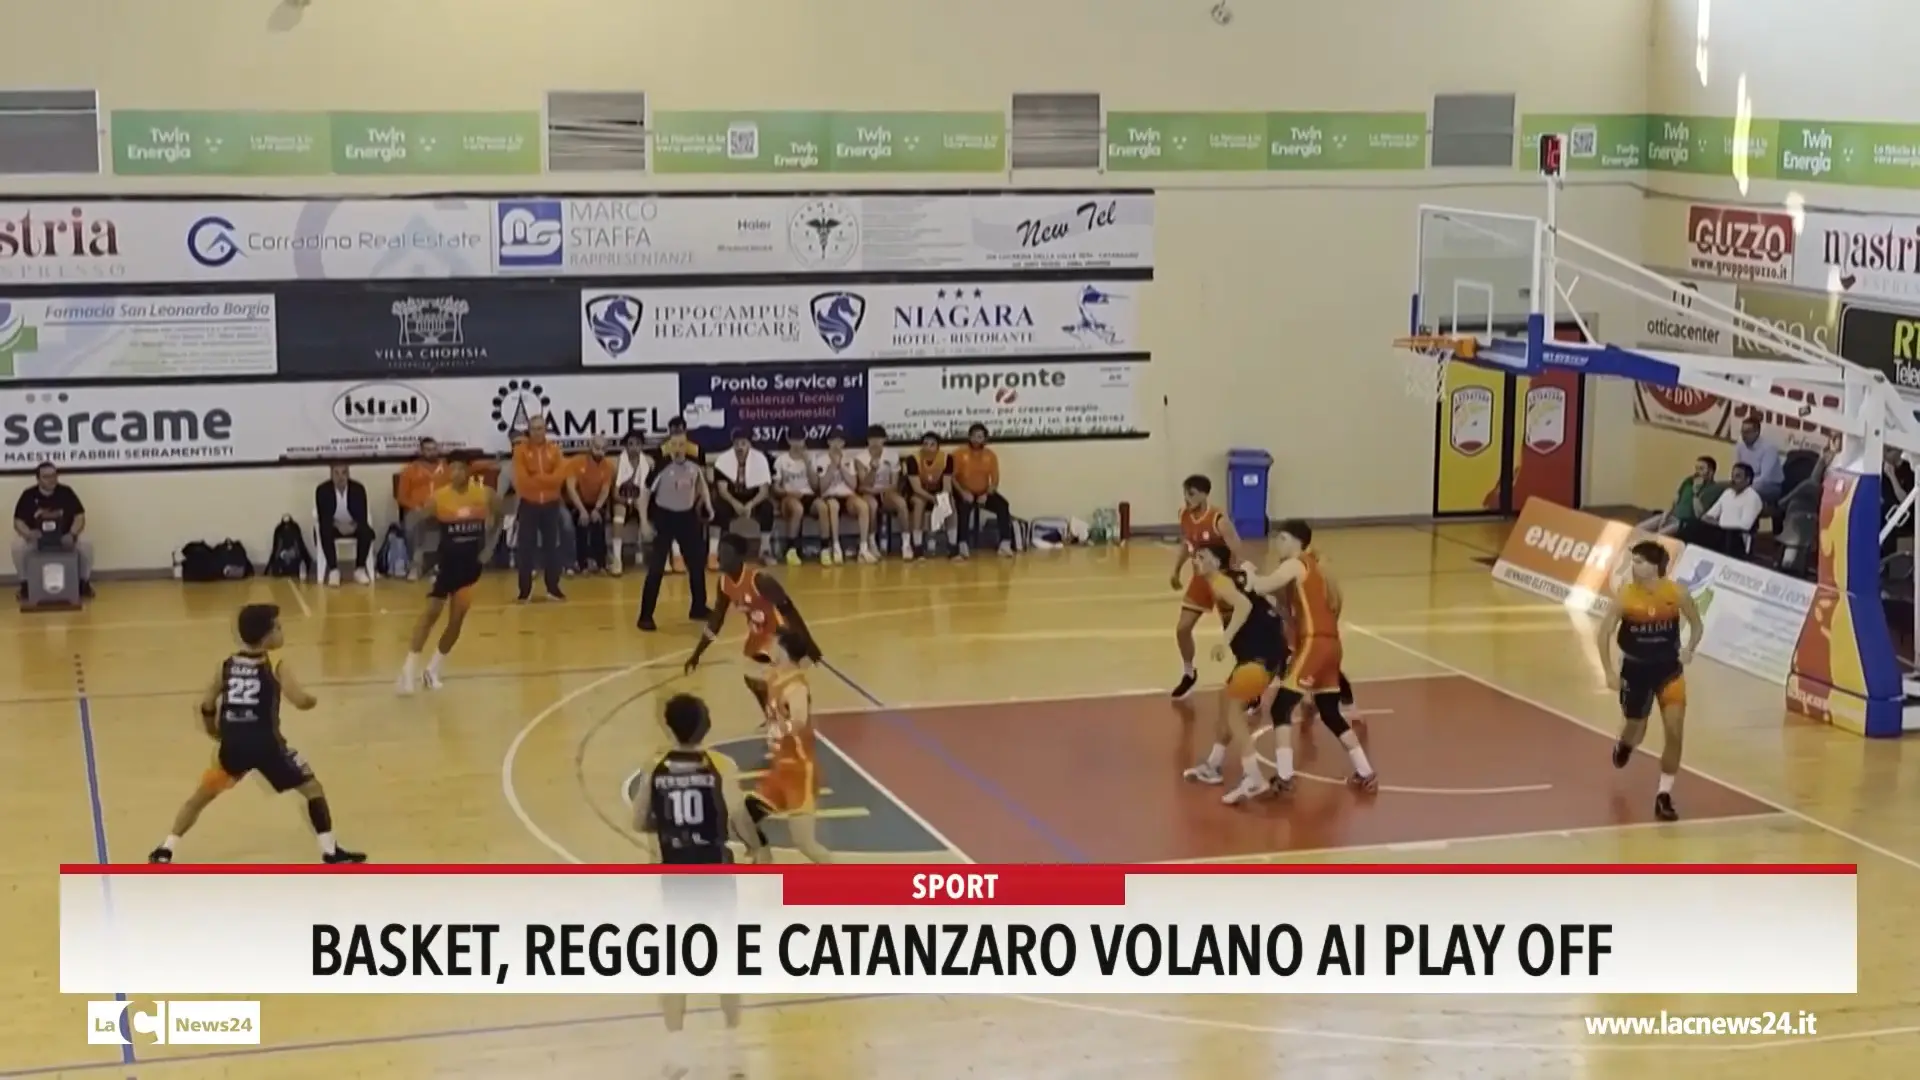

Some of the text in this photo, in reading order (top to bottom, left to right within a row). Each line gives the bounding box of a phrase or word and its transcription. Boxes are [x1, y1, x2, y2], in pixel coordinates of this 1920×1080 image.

[150, 127, 190, 143] Twin
[366, 127, 406, 143] Twin
[855, 127, 891, 143] Twin
[1127, 127, 1161, 142] Twin
[1290, 126, 1322, 142] Twin
[1663, 121, 1690, 142] Twin
[1801, 127, 1833, 149] Twin
[127, 143, 191, 162] Energia
[345, 143, 406, 162] Energia
[836, 142, 892, 161] Energia
[1108, 141, 1161, 159] Energia
[1271, 141, 1322, 159] Energia
[1782, 151, 1832, 176] Energia
[570, 200, 659, 221] MARCO
[0, 206, 120, 258] stria
[1017, 200, 1118, 248] New Tel
[248, 231, 482, 251] Corradino Real Estate
[570, 227, 652, 248] STAFFA
[1695, 218, 1786, 263] GUZZO
[570, 252, 695, 267] RAPPRESENTANZE
[45, 302, 270, 320] Farmacia San Leonardo Borgia
[654, 305, 800, 321] IPPOCAMPUS
[893, 304, 1034, 329] NIAGARA
[653, 322, 801, 339] HEALTHCARE
[892, 332, 940, 346] HOTEL
[949, 331, 1034, 345] RISTORANTE
[1647, 317, 1721, 345] otticacenter
[375, 347, 488, 360] VILLA CHORISIA
[710, 374, 769, 392] Pronto
[773, 373, 838, 390] Service
[842, 372, 864, 388] srl
[940, 368, 1066, 395] impronte
[345, 395, 418, 416] istral
[730, 392, 845, 406] Assistenza Tecnica
[738, 406, 837, 420] Elettrodomestici
[3, 406, 233, 447] sercame
[4, 446, 235, 463] MAESTRI FABBRI SERRAMENTISTI
[227, 677, 262, 705] 22
[667, 789, 705, 827] 10
